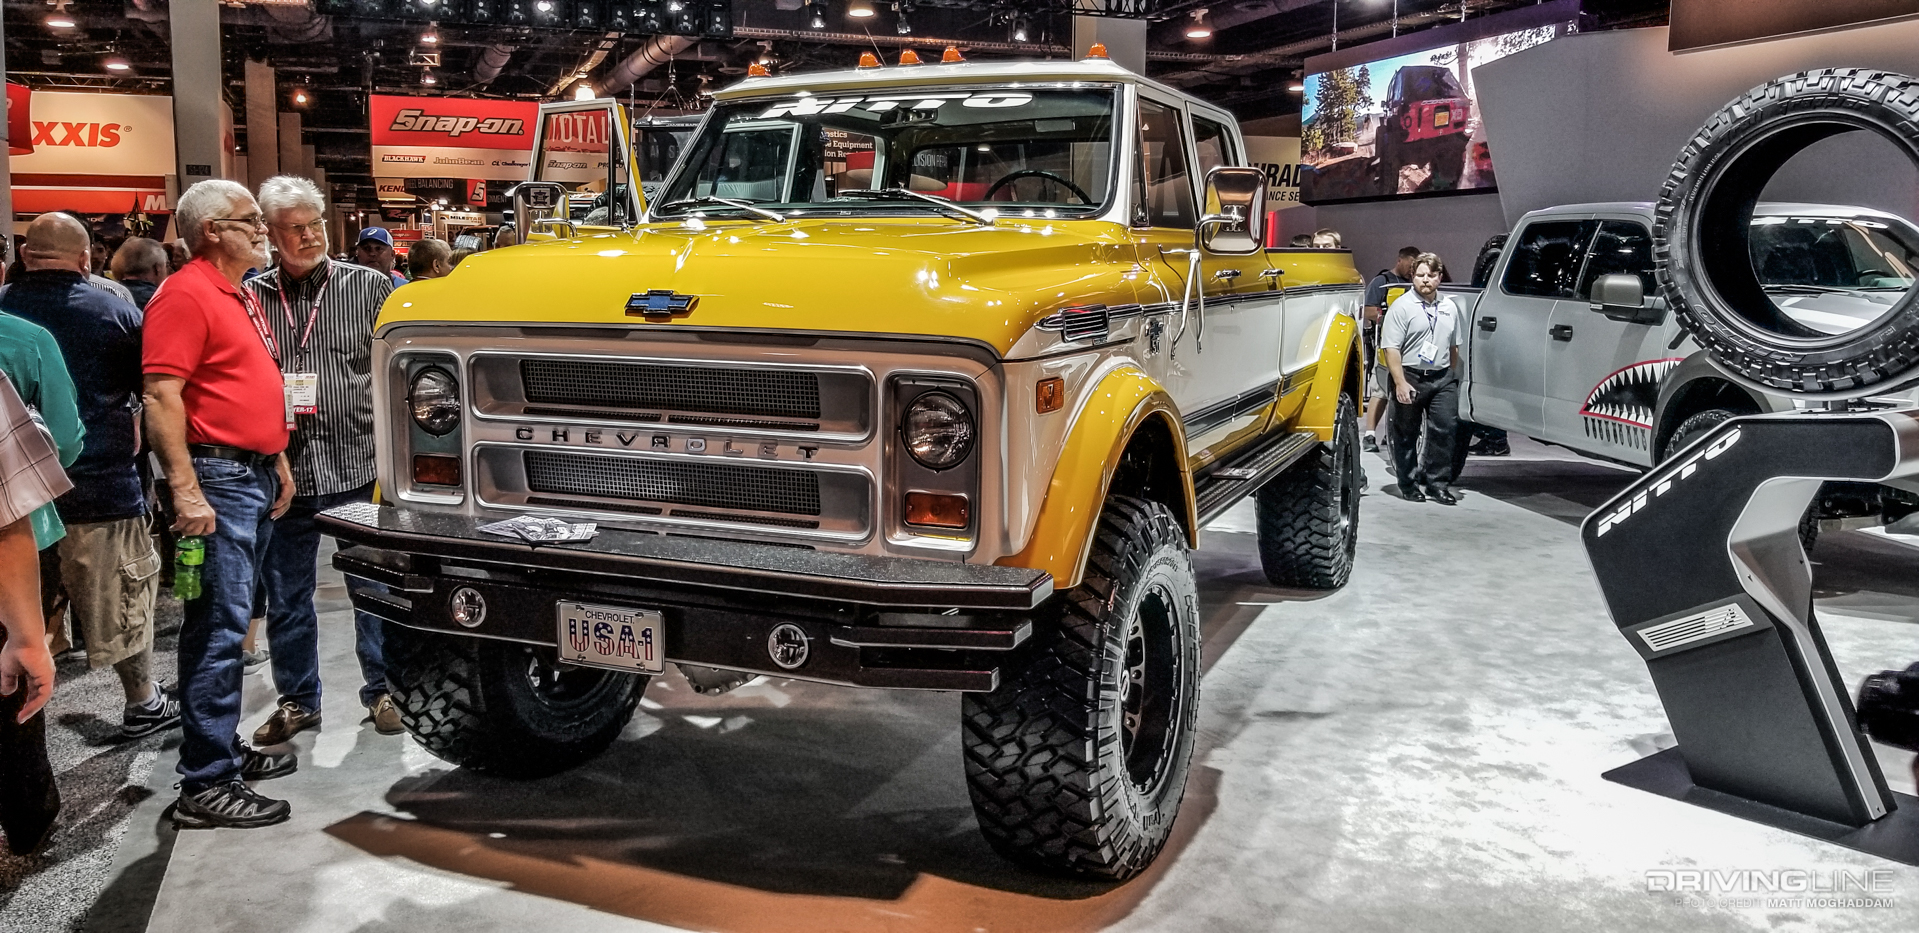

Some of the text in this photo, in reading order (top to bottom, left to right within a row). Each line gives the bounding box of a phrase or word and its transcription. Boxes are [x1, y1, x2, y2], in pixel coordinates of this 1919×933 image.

[758, 92, 1033, 118] NITTO
[390, 109, 524, 137] Snap-on
[833, 141, 873, 149] Equipment
[383, 155, 424, 163] BLACKHAWK
[418, 178, 454, 189] BALANCING
[515, 426, 819, 462] CHEVROLET
[1597, 427, 1742, 537] NITTO
[584, 609, 635, 625] CHEVROLET
